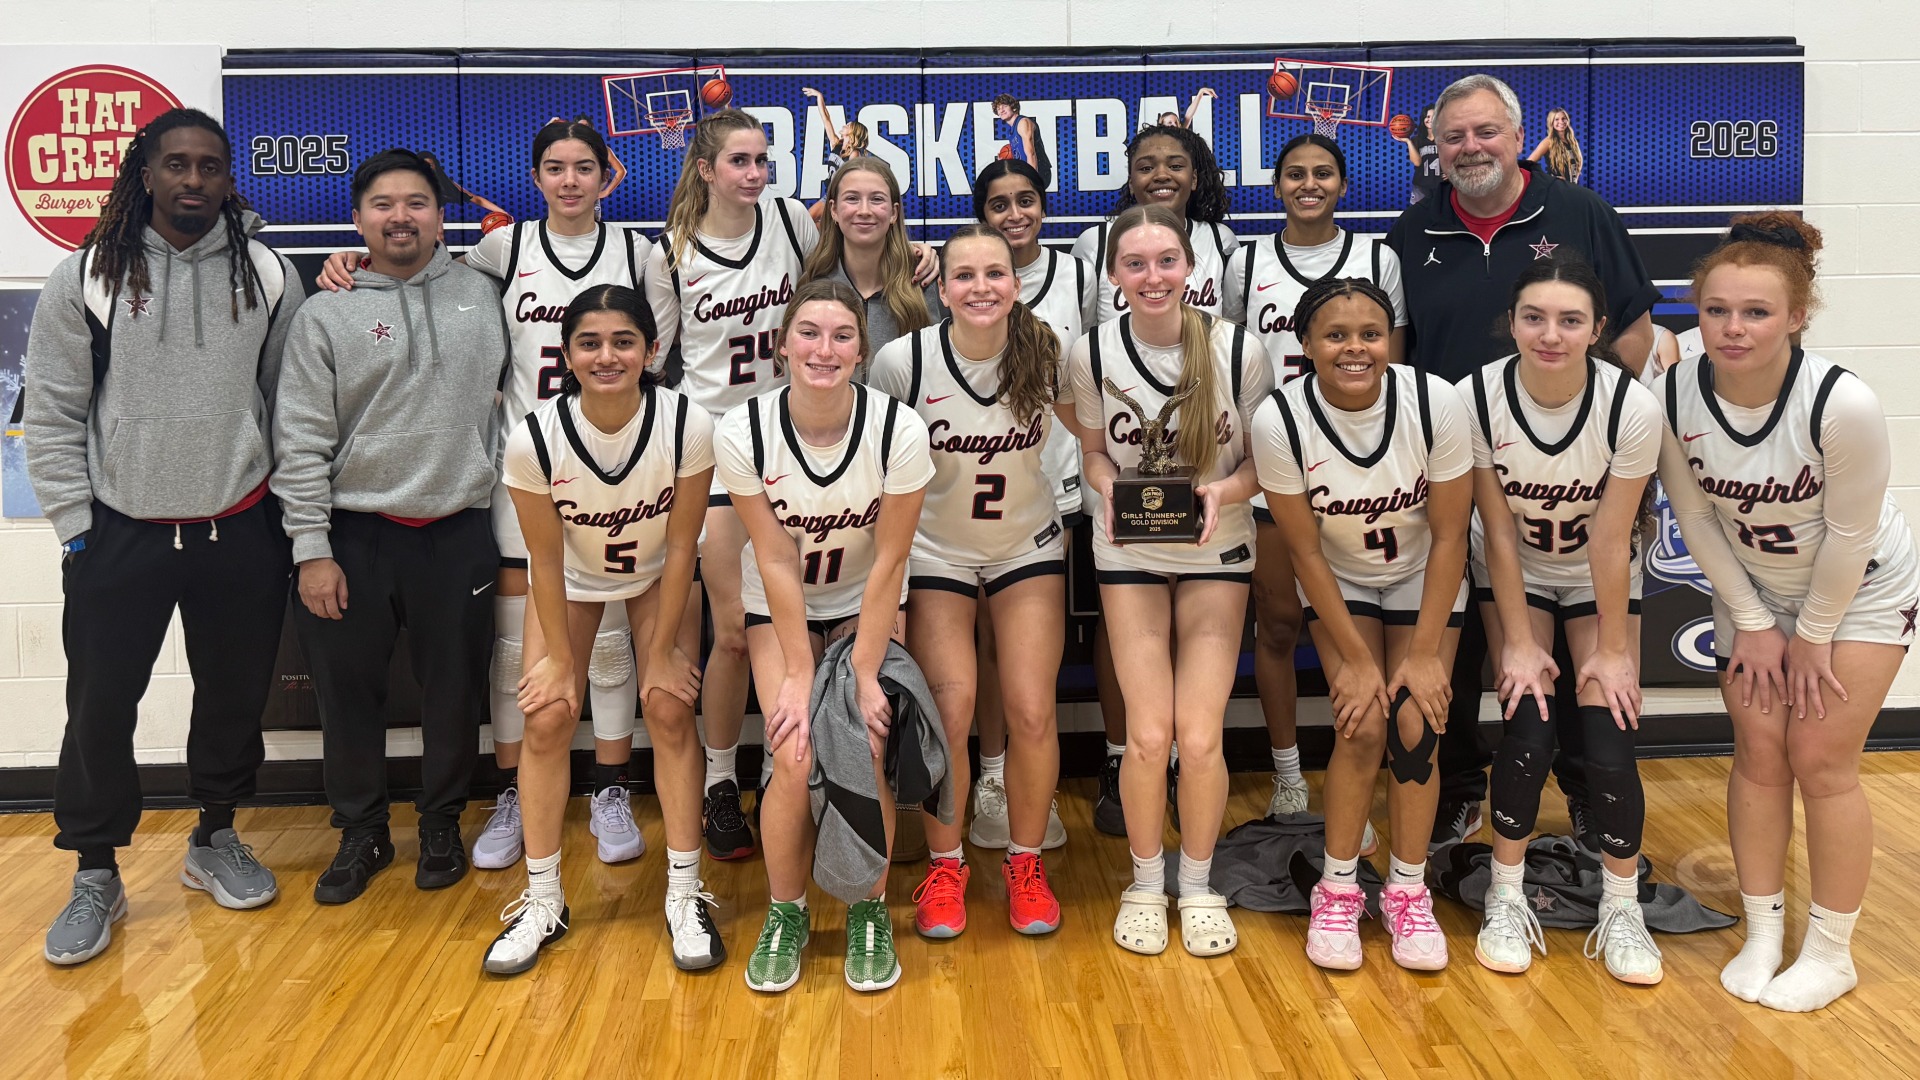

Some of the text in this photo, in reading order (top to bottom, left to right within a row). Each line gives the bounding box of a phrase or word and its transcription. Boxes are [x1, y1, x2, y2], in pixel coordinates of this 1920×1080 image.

[57, 88, 141, 136] HAT
[251, 134, 350, 175] 2025
[741, 93, 1275, 200] BASKTBLL
[1690, 120, 1778, 158] 2026
[34, 193, 94, 214] Burger
[1113, 278, 1218, 312] Cirls
[971, 473, 1007, 521] 2
[1493, 463, 1611, 511] owgirl
[1363, 526, 1398, 563] 4
[1522, 513, 1591, 555] 35
[603, 539, 639, 574] 5
[802, 546, 845, 586] 11
